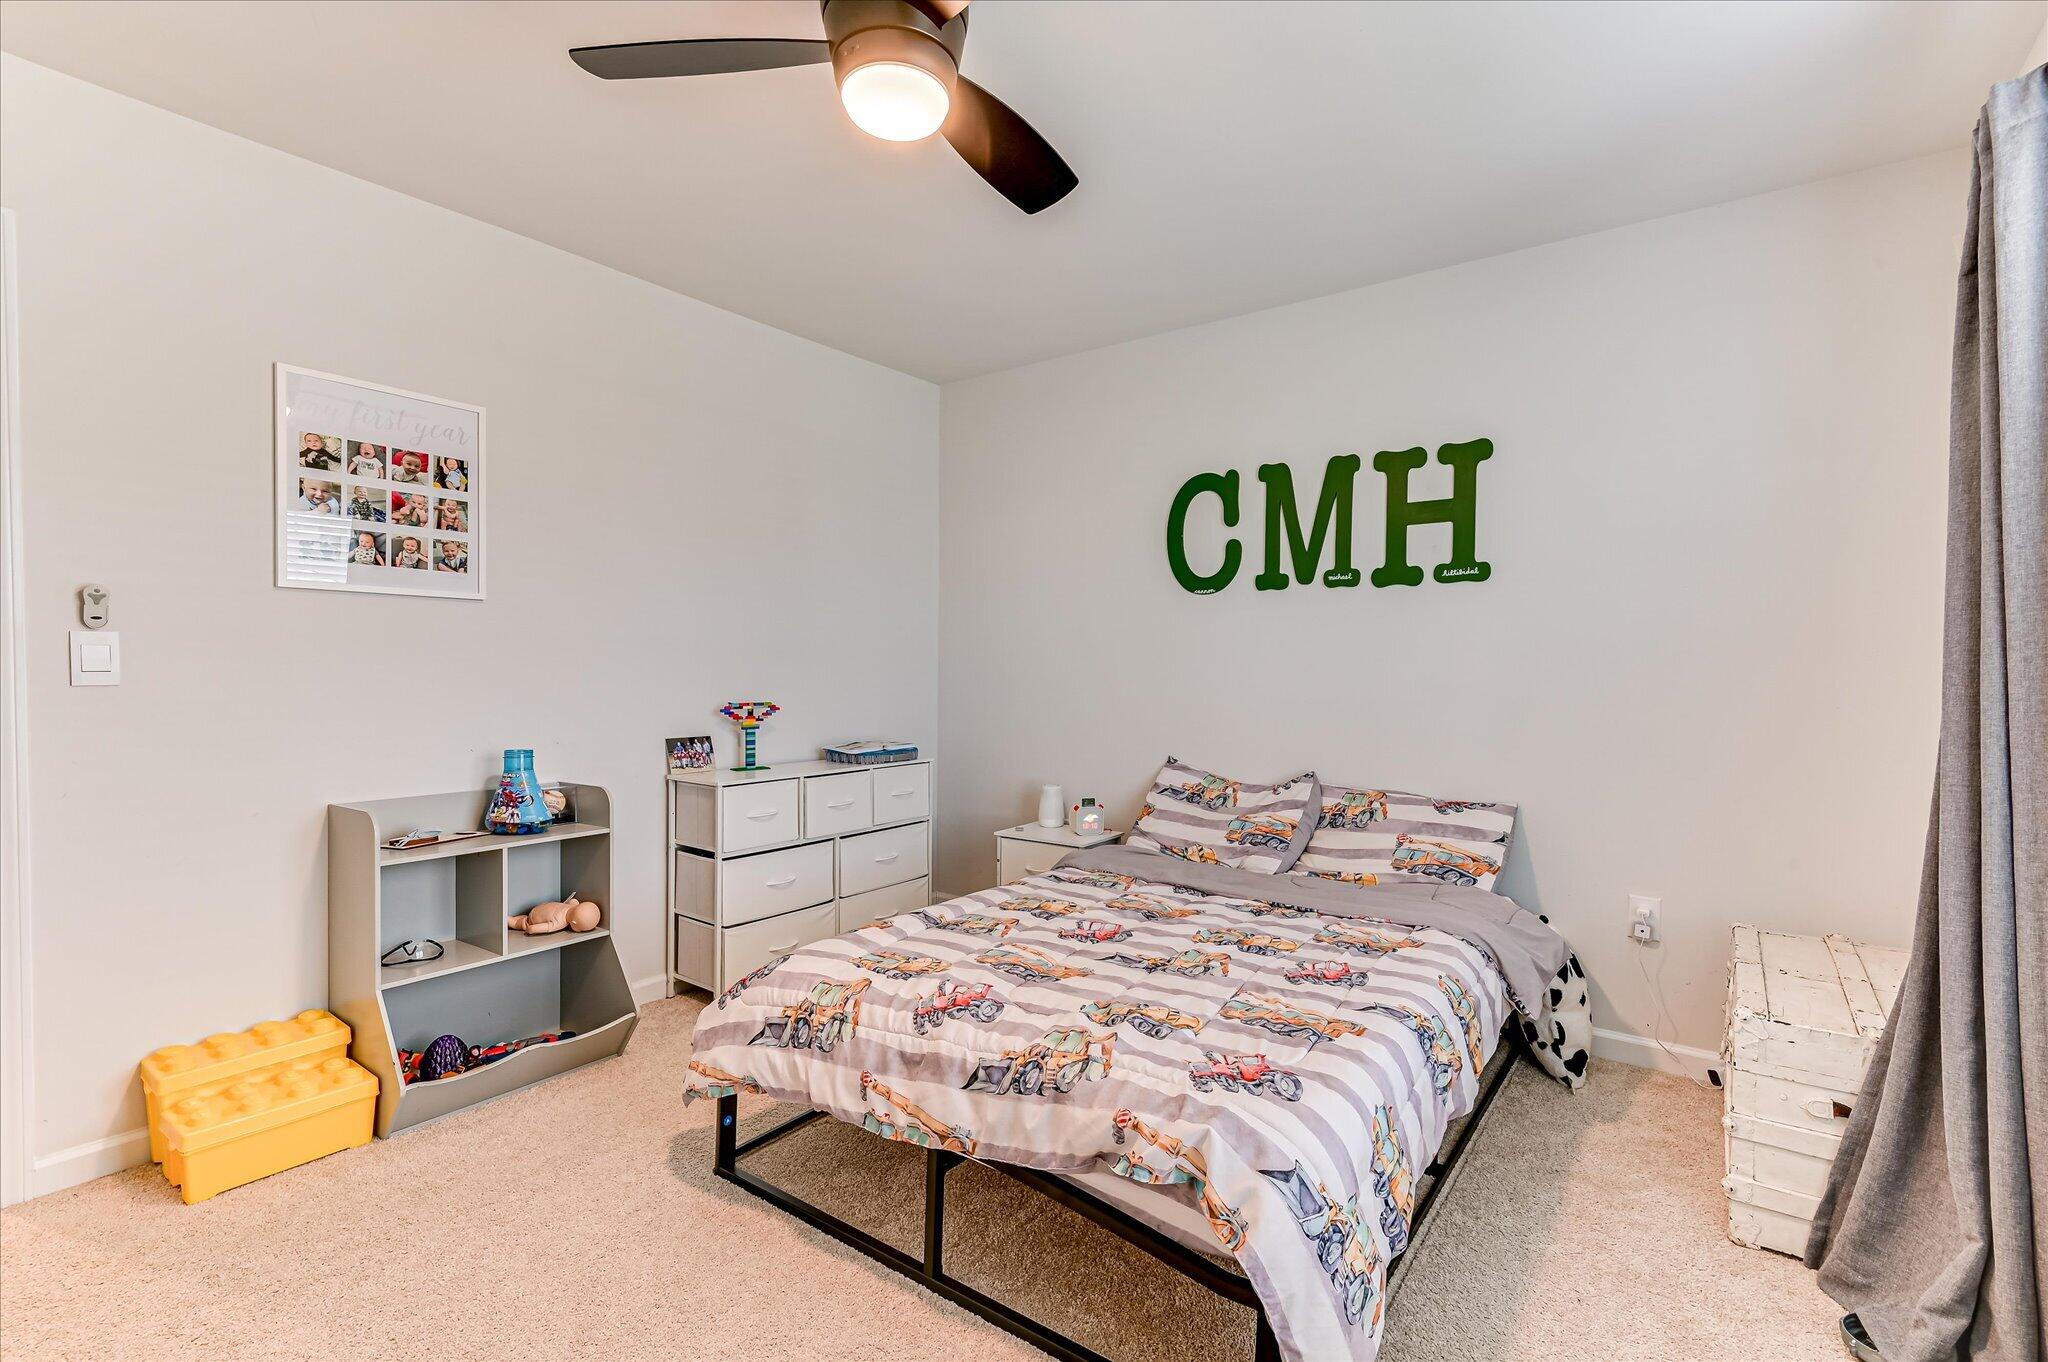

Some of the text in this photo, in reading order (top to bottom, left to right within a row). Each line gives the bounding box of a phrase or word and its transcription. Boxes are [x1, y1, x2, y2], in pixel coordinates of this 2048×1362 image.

[349, 400, 425, 431] first
[408, 421, 472, 447] year
[1167, 437, 1494, 596] CMH
